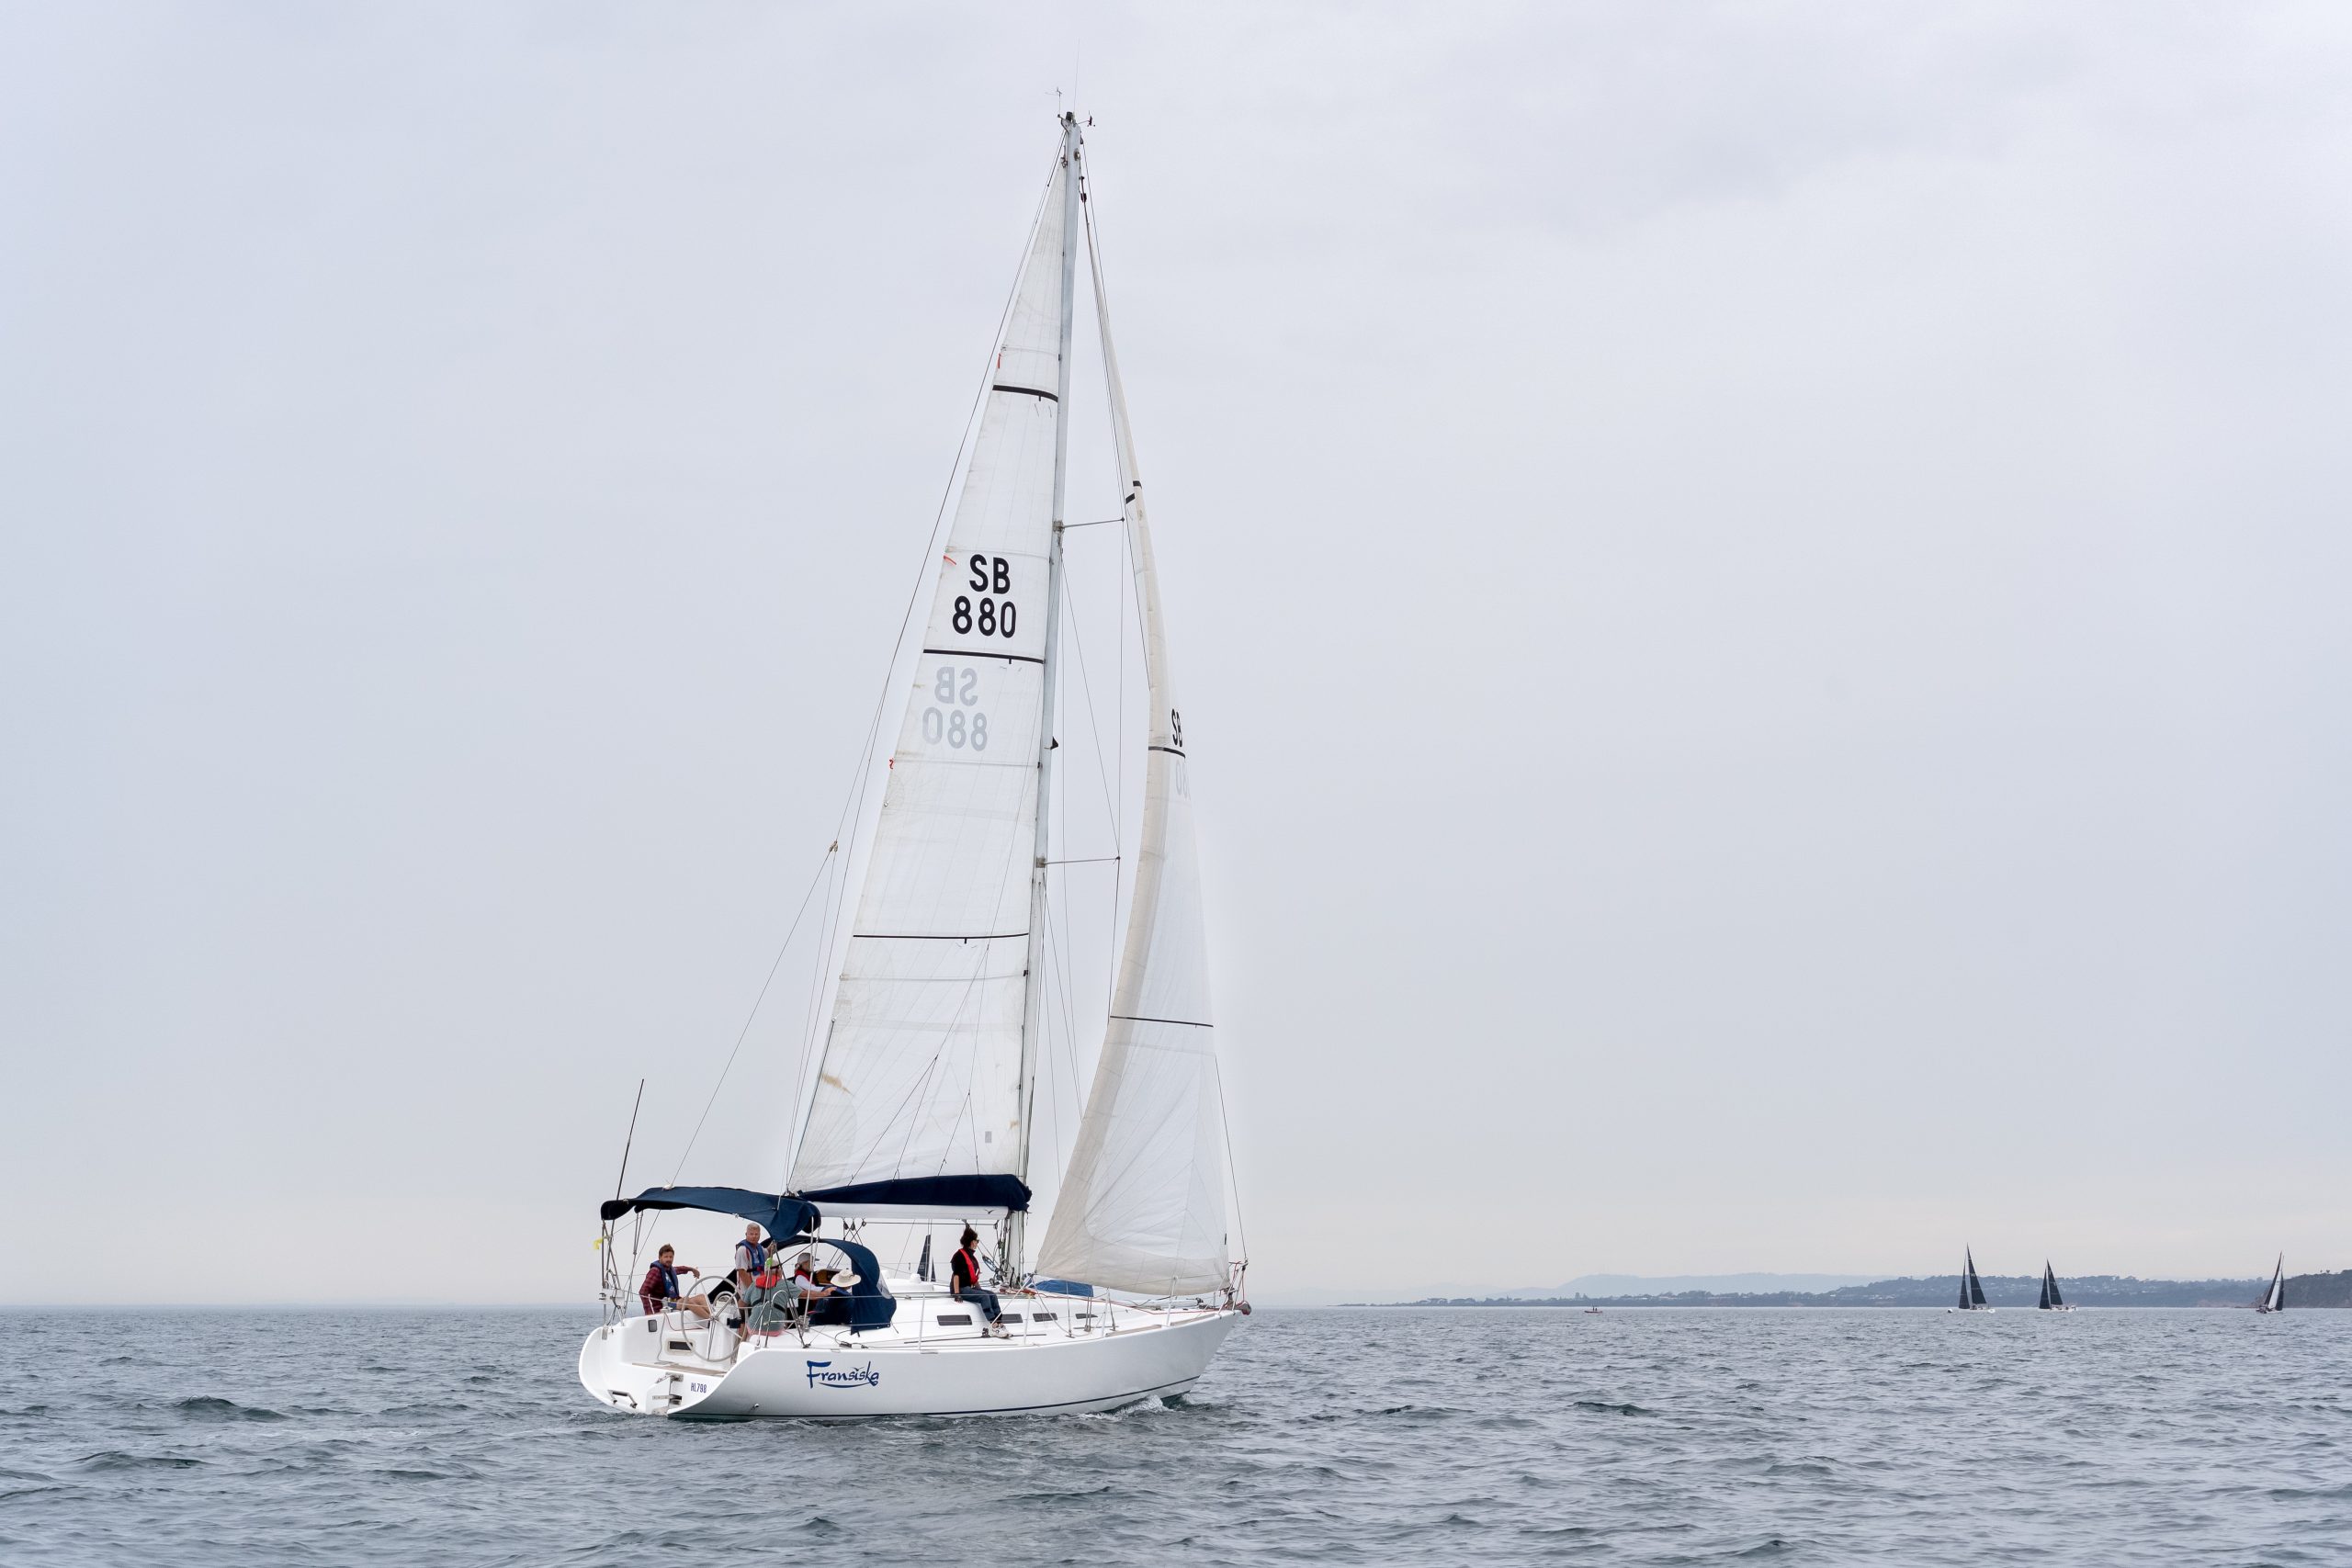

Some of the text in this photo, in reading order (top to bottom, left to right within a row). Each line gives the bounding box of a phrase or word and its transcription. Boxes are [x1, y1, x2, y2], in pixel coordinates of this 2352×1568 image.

[969, 554, 1011, 594] SB
[953, 595, 1016, 638] 880
[806, 1360, 879, 1389] Fransiska
